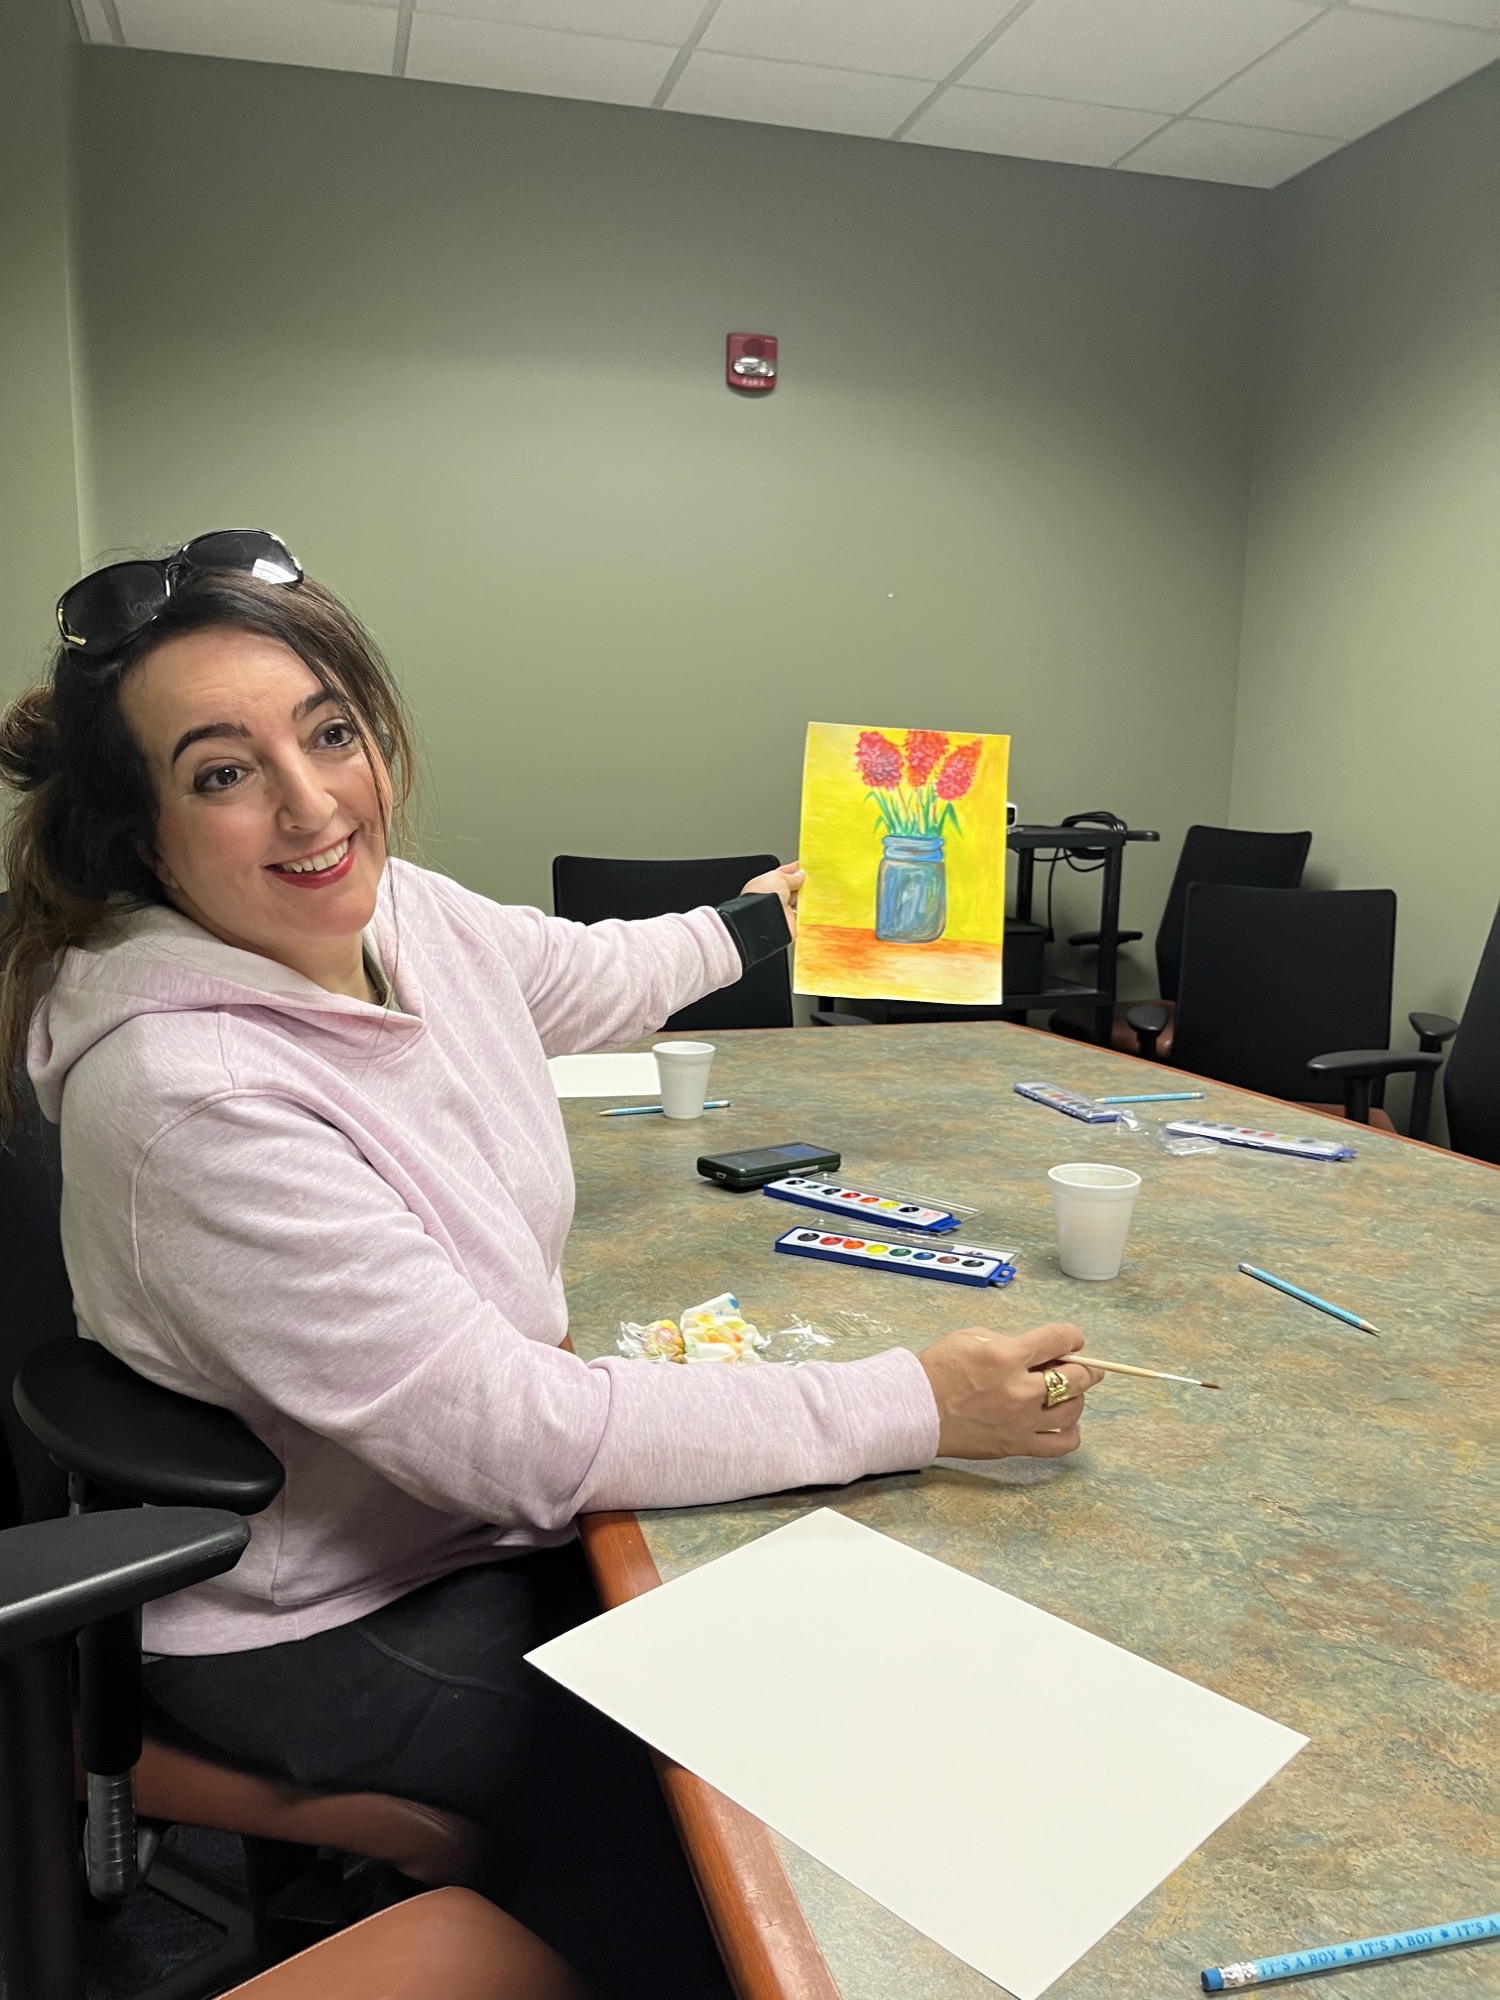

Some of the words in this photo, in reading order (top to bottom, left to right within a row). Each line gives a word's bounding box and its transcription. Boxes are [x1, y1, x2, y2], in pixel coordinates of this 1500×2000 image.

[1261, 1958, 1291, 1976] IT'S
[1295, 1955, 1306, 1969] A
[1308, 1949, 1337, 1966] BOY
[1358, 1940, 1389, 1956] IT'S
[1394, 1937, 1404, 1950] A
[1405, 1931, 1434, 1947] BOY
[1455, 1921, 1485, 1938] IT'S
[1488, 1919, 1500, 1932] A
